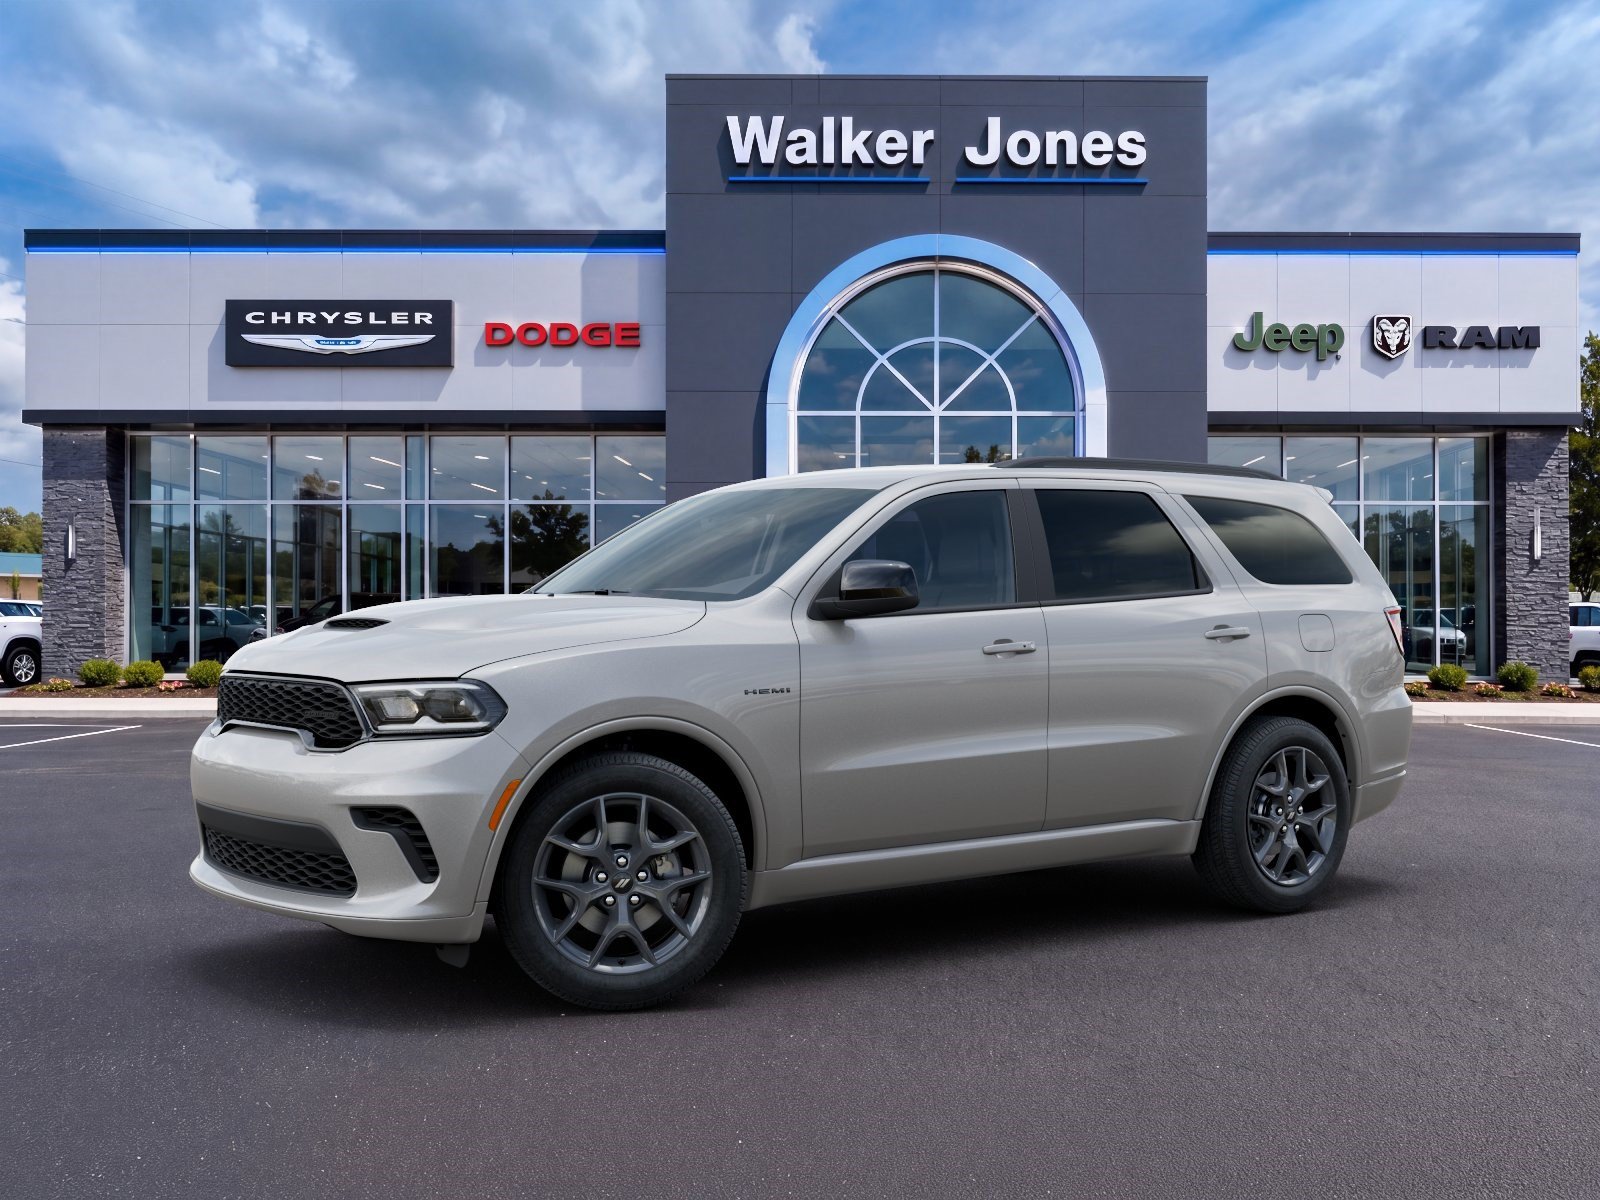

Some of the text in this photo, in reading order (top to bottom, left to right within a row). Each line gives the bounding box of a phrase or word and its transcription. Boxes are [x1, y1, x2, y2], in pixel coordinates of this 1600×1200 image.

[726, 115, 1147, 166] Walker Jones
[245, 311, 433, 325] CHRYSLER
[485, 322, 641, 347] DODGE
[1234, 312, 1345, 361] Jeep
[1423, 326, 1541, 349] RAM
[744, 687, 791, 695] HEMI
